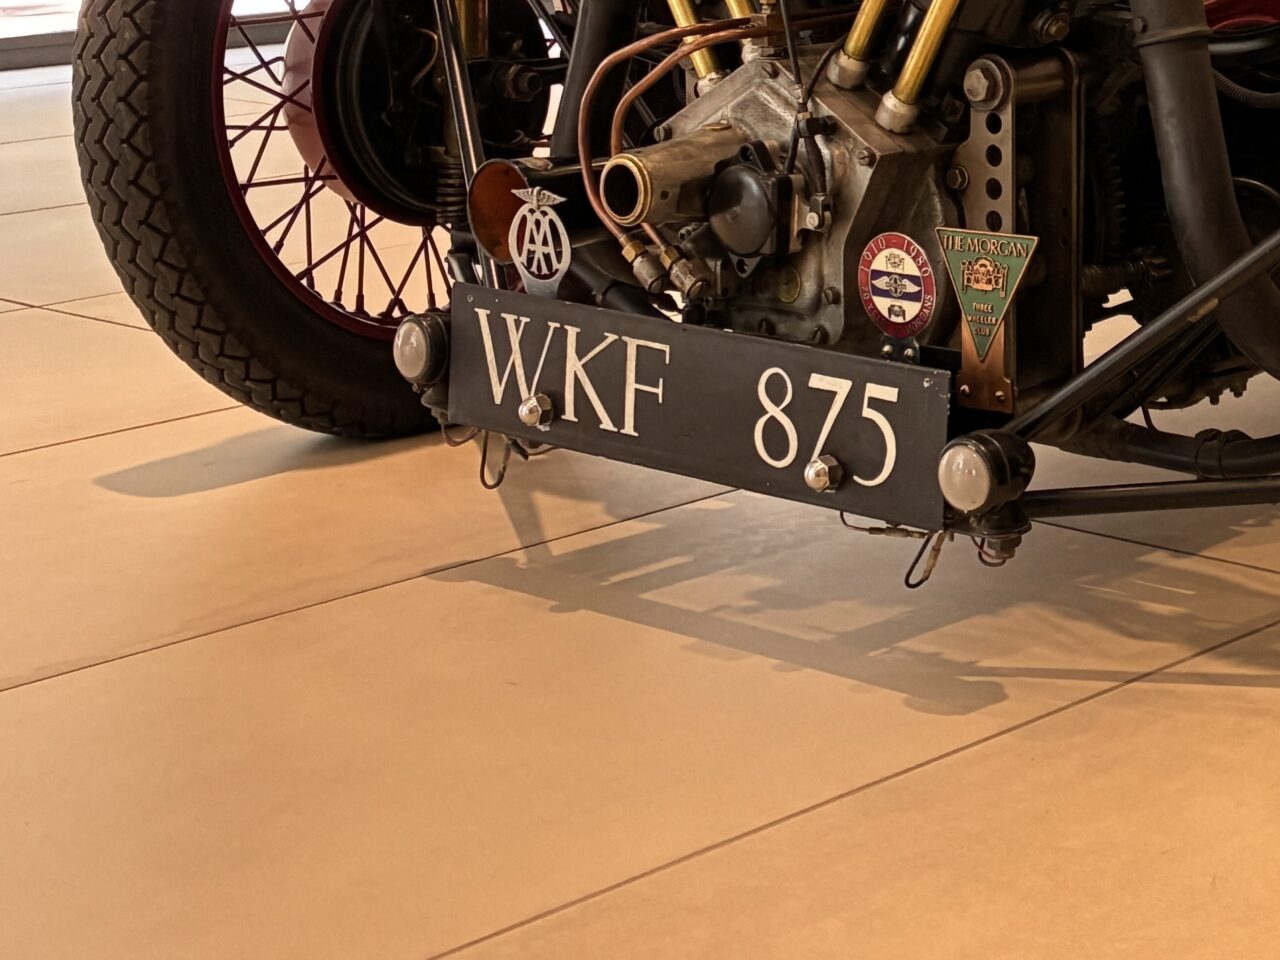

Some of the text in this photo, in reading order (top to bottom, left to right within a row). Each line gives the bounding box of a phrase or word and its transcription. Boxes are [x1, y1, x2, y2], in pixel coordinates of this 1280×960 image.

[903, 239, 931, 278] 1980
[943, 235, 1028, 258] THE MORGAN
[973, 302, 993, 313] THREE
[474, 307, 900, 488] WKF 875
